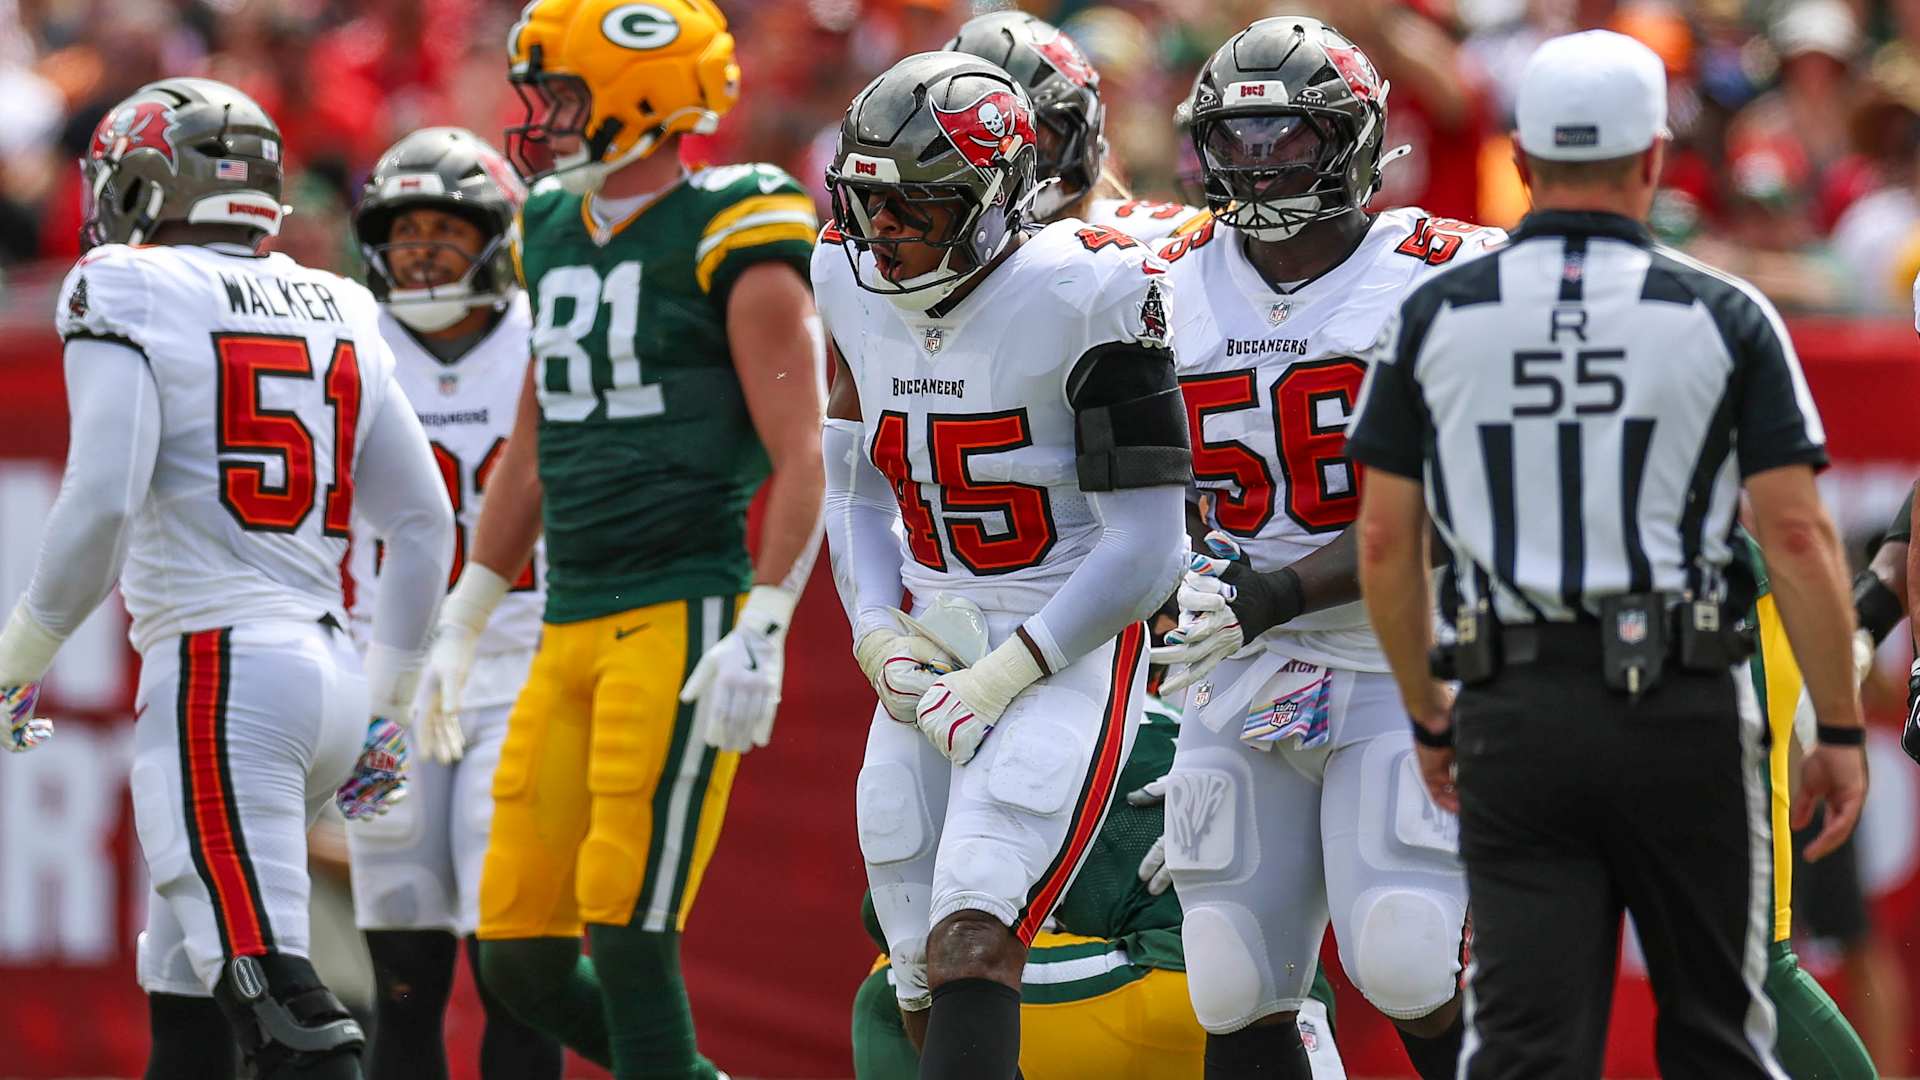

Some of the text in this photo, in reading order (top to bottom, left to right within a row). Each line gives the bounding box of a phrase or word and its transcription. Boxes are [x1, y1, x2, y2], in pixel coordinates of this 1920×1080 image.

[601, 4, 680, 50] G
[218, 271, 344, 323] WALKER
[532, 260, 665, 421] 81
[1227, 338, 1307, 357] BUCCANEERS
[1551, 309, 1588, 343] R
[892, 377, 965, 399] BUCCANEERS
[1512, 350, 1626, 417] 55
[210, 331, 362, 538] 51
[1178, 356, 1368, 538] 56
[870, 407, 1058, 576] 45
[1280, 658, 1320, 674] ATCH
